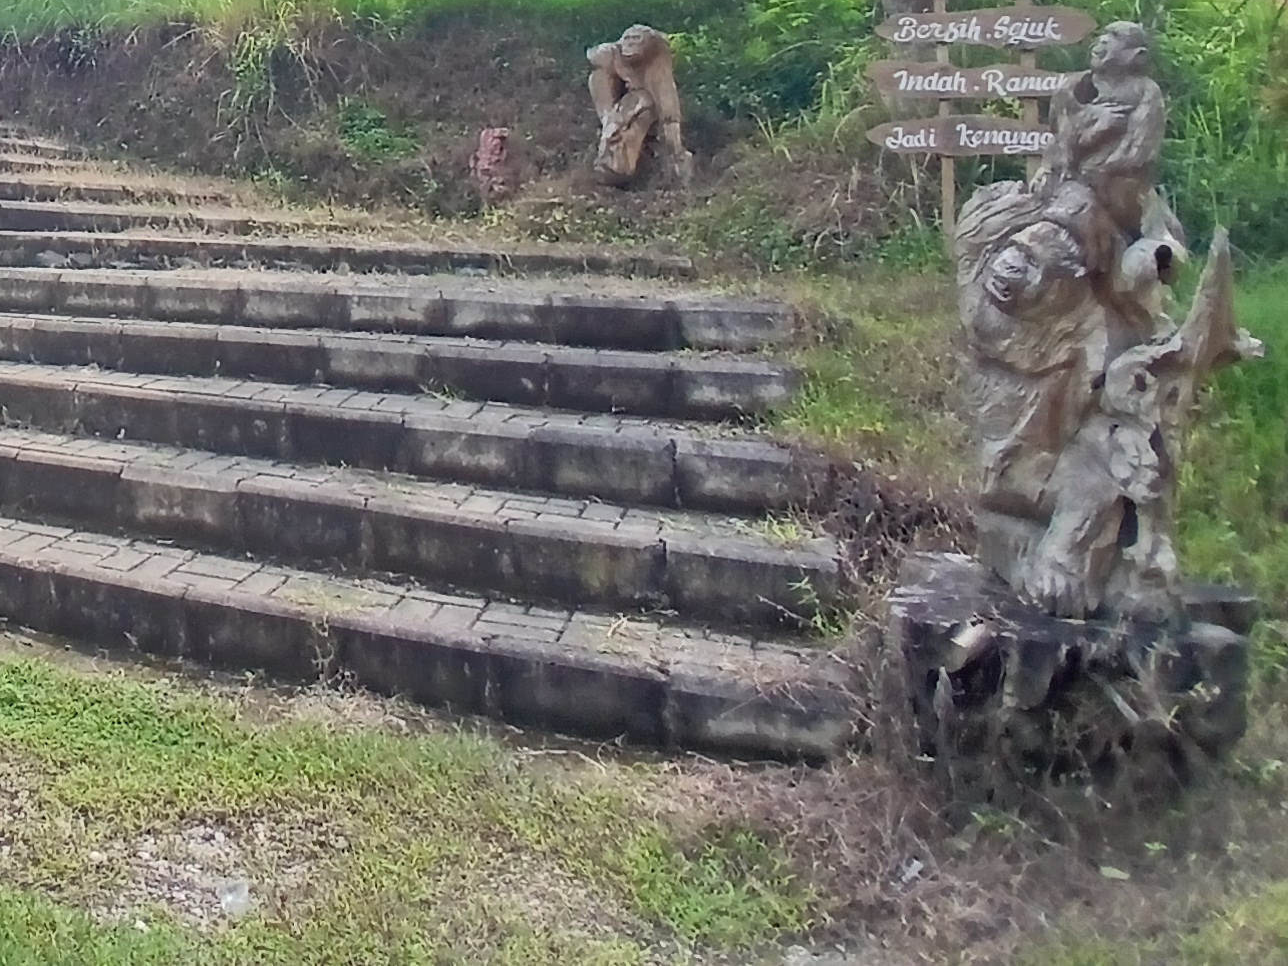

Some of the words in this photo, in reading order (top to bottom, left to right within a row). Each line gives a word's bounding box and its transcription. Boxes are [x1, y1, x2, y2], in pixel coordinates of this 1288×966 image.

[893, 16, 981, 42] Bersih
[994, 15, 1062, 45] Sejuk
[893, 70, 967, 94] Indah
[885, 126, 937, 149] Jadi
